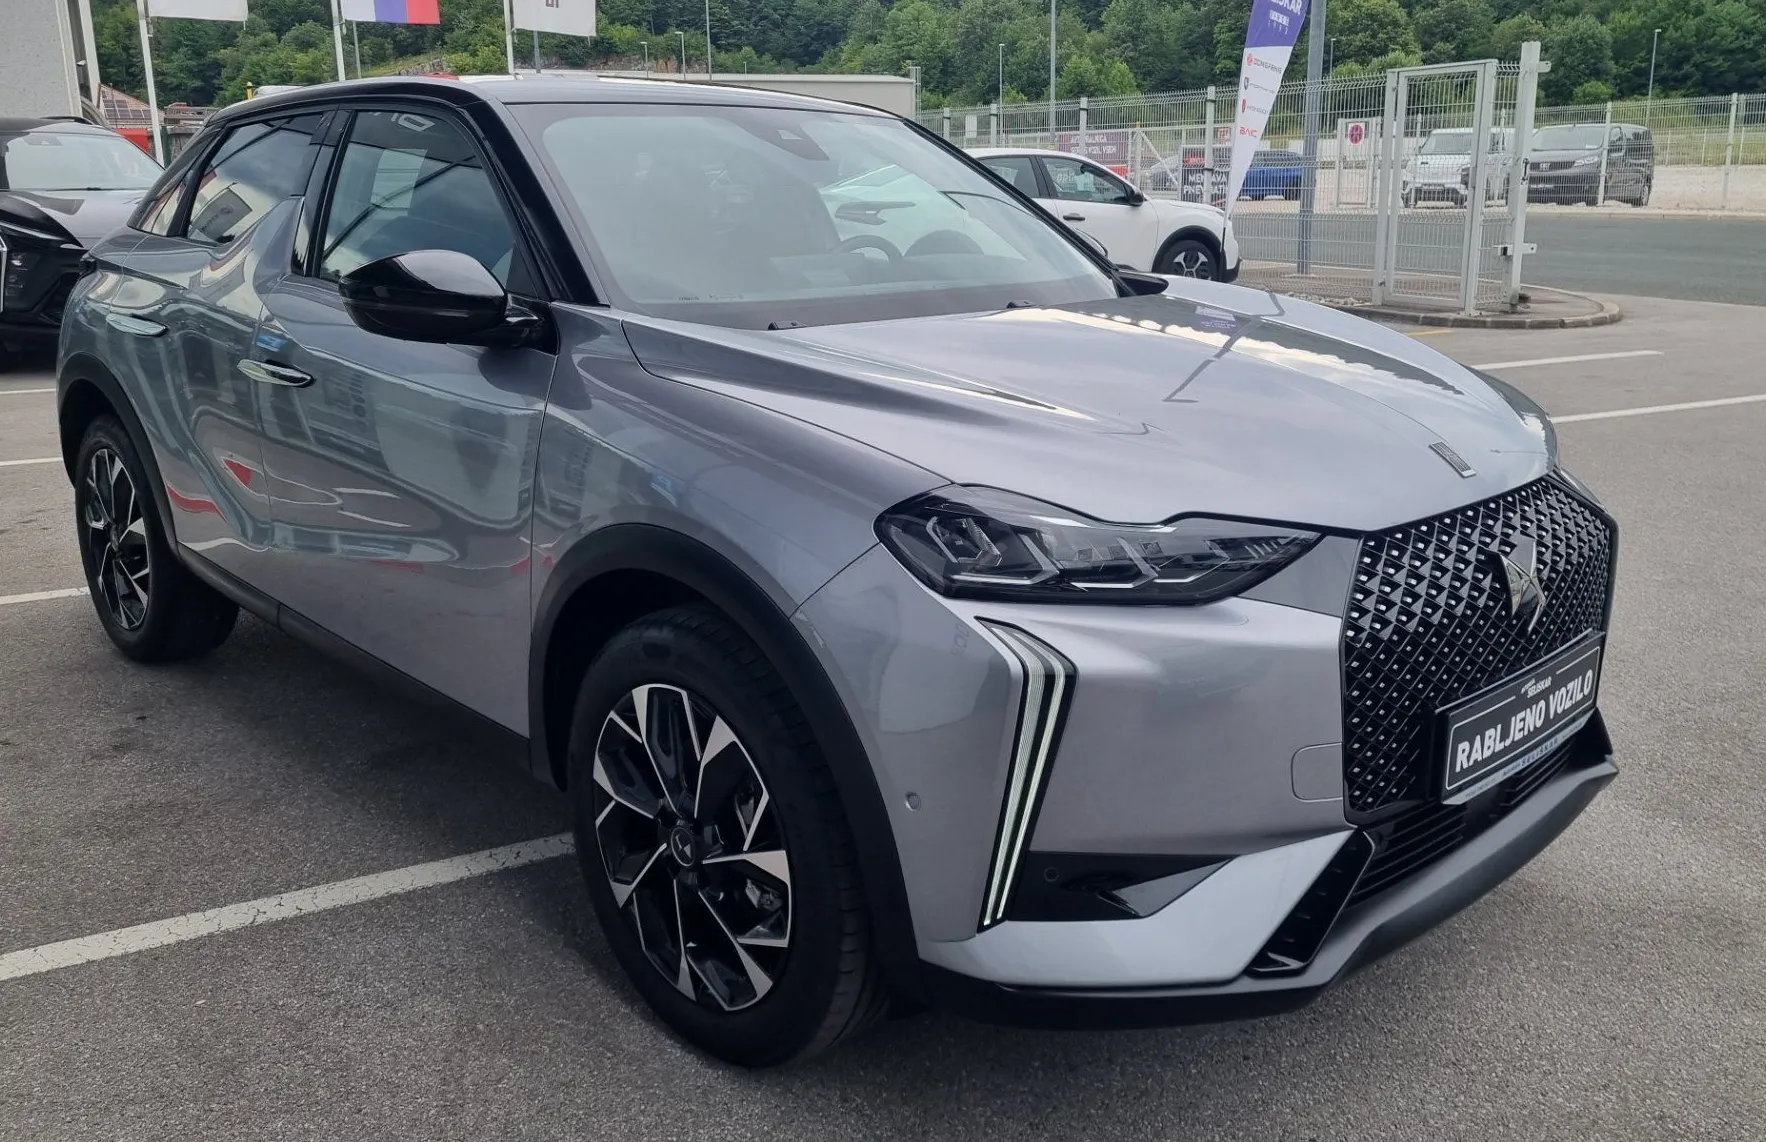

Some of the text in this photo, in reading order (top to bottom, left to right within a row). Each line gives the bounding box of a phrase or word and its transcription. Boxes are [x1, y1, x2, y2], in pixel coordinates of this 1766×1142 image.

[1188, 173, 1227, 182] MENAVA
[1455, 669, 1593, 773] RABLJENO VOZILO
